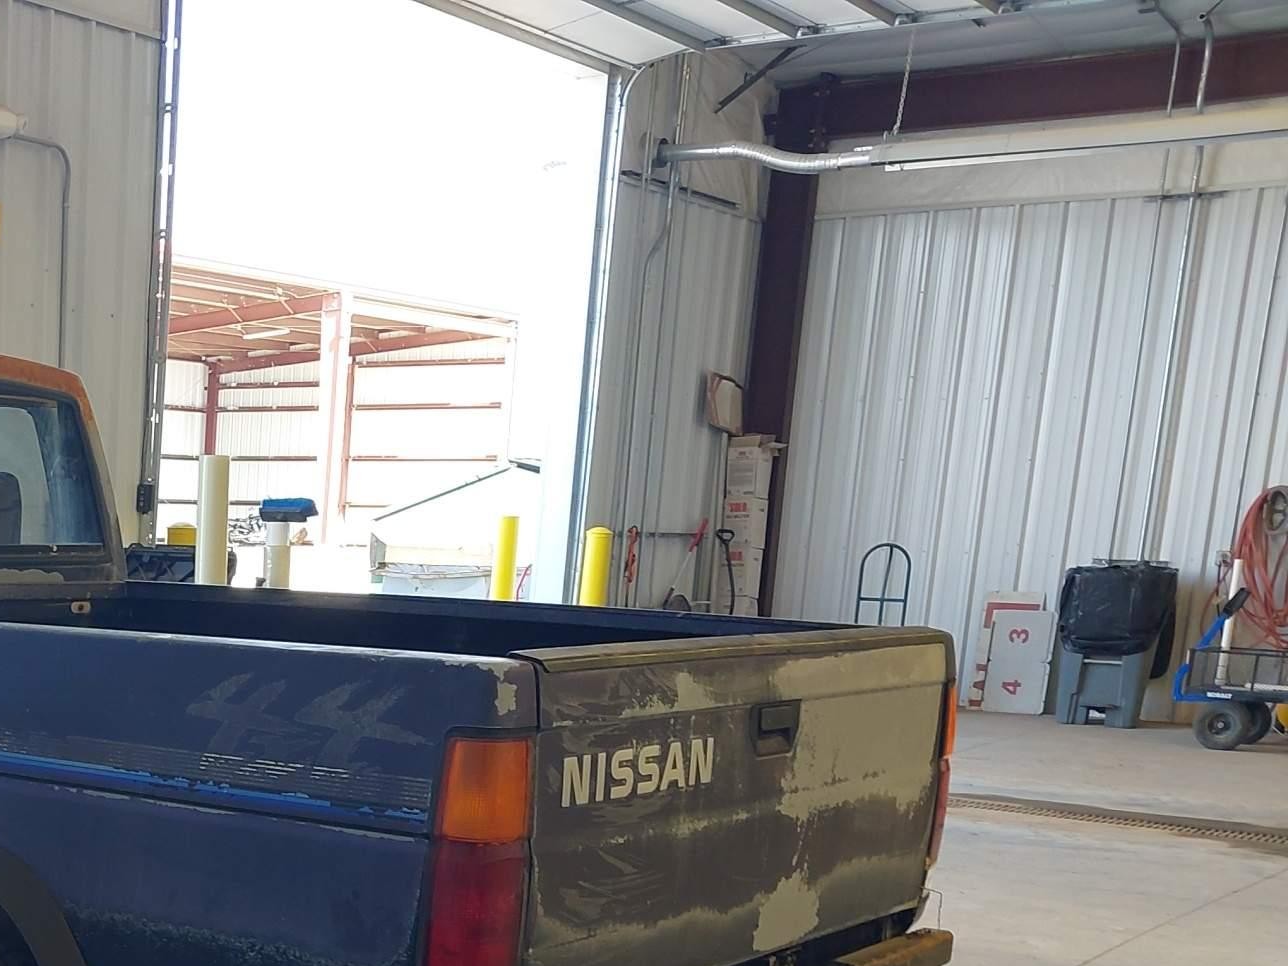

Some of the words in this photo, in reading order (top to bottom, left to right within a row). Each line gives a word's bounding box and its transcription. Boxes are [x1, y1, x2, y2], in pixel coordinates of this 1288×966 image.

[1008, 628, 1030, 644] 3
[1001, 679, 1022, 696] 4
[561, 736, 715, 808] NISSAN
